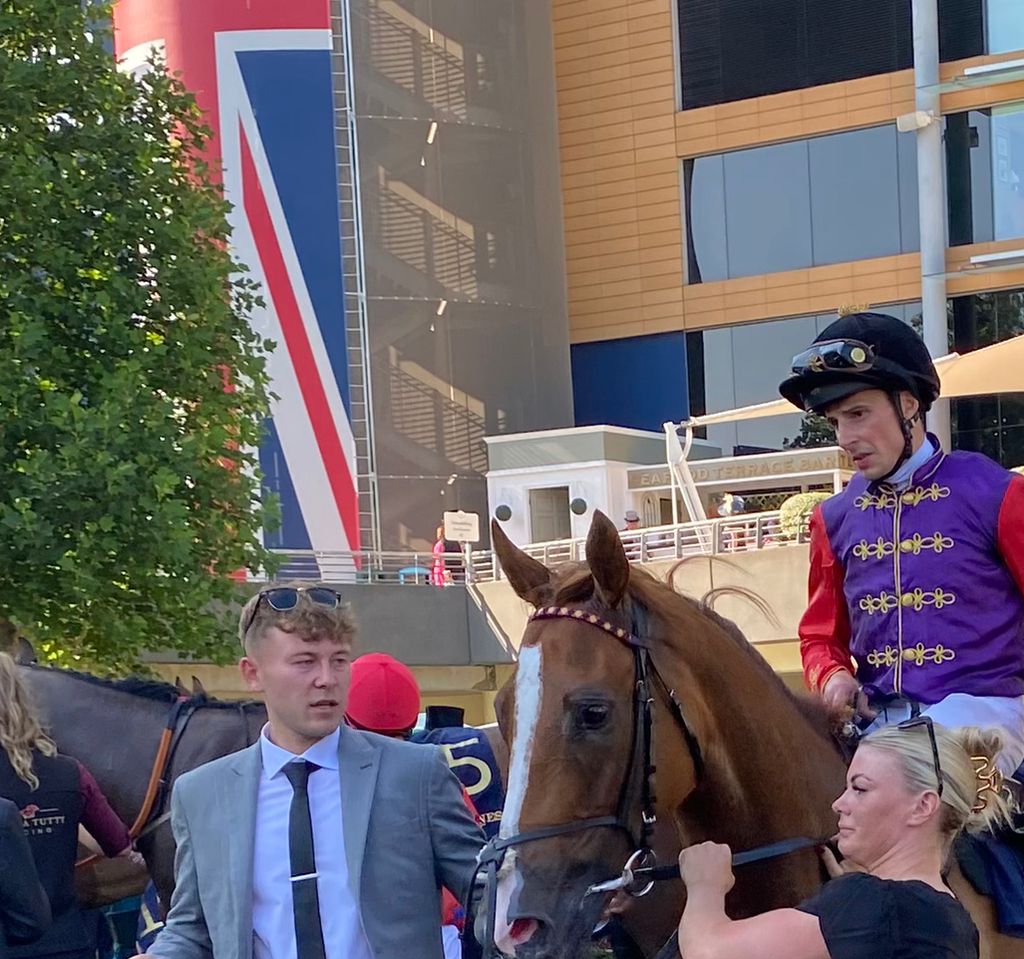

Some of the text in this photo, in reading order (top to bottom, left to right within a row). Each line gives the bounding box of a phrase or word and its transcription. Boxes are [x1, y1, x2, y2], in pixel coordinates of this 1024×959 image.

[717, 459, 794, 480] TERRACE
[441, 738, 492, 796] 5
[33, 815, 65, 827] TUTTI
[23, 827, 52, 836] CING
